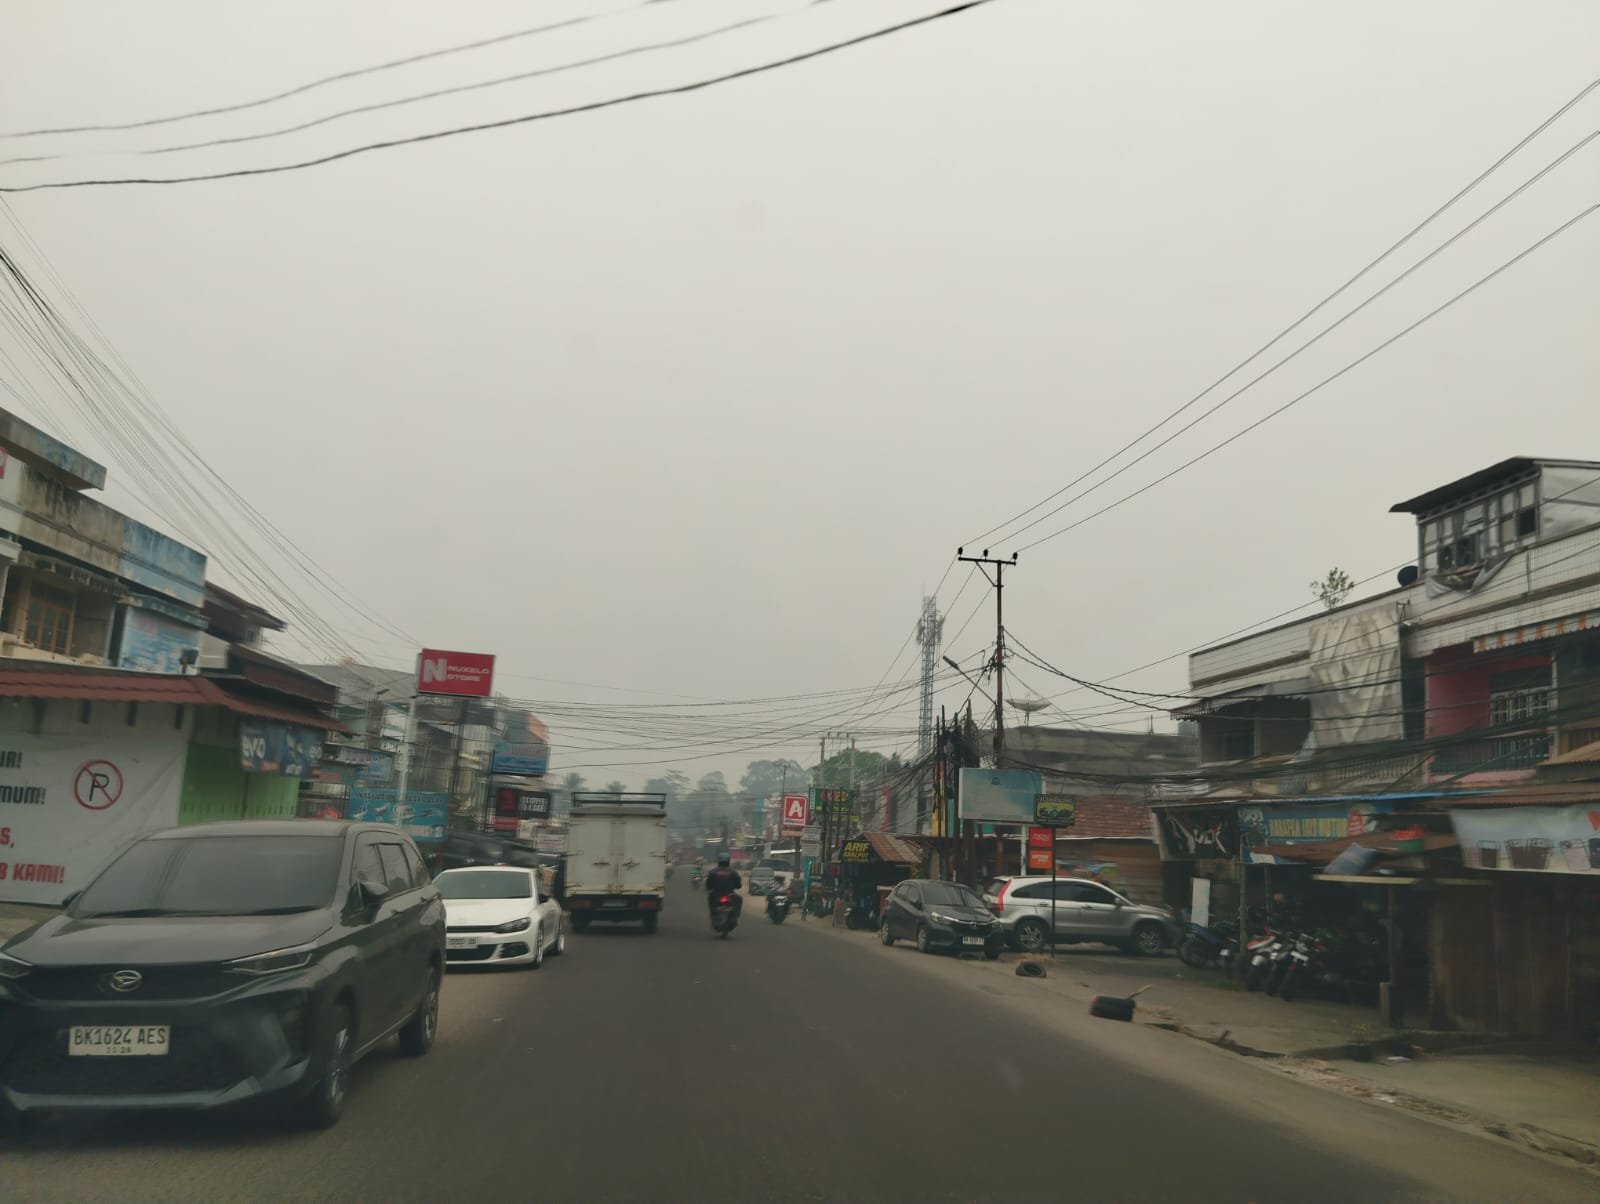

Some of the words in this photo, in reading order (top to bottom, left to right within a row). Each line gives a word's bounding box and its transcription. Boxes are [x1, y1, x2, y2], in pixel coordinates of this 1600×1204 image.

[844, 842, 870, 852] ARIF
[12, 863, 65, 884] KAMI!
[137, 1028, 165, 1044] AES
